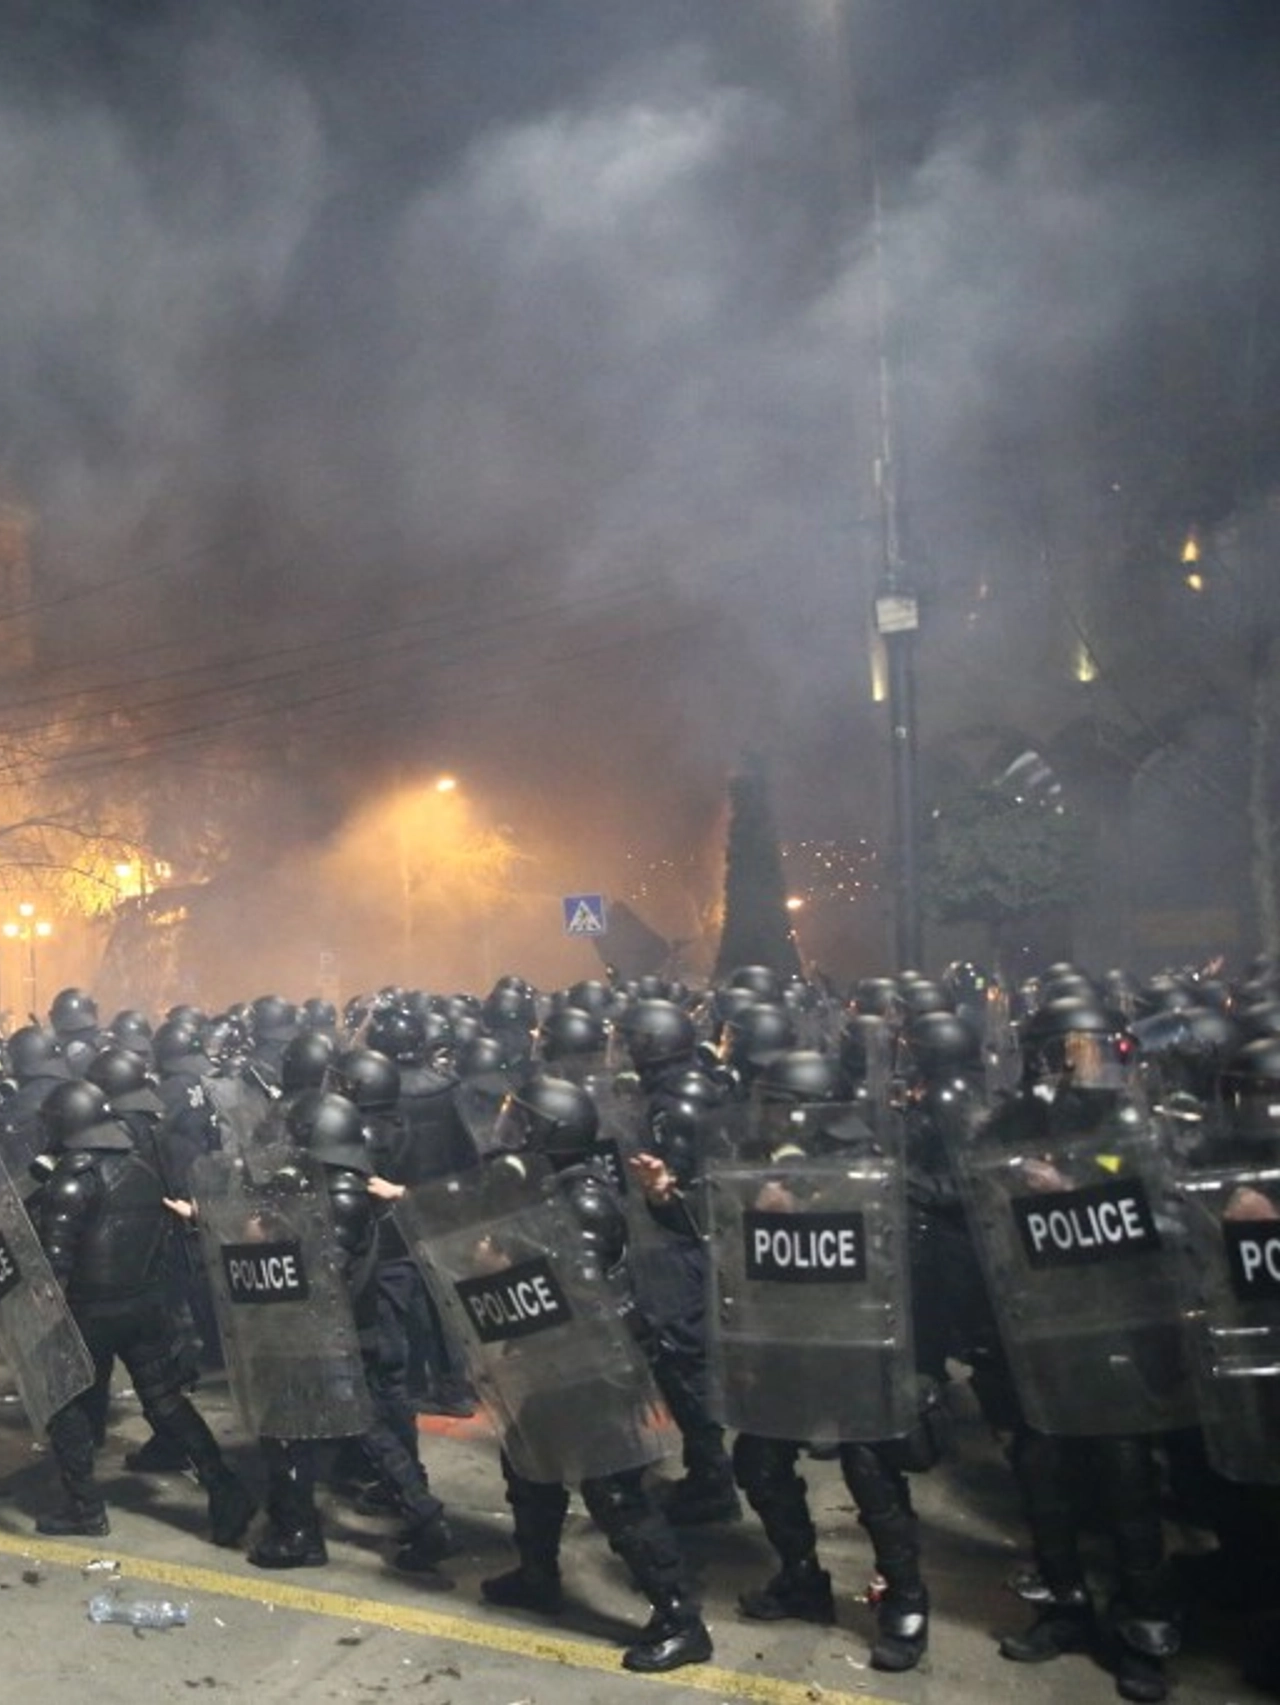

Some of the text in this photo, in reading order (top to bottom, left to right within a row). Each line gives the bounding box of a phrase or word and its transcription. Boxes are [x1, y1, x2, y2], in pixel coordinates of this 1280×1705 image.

[1027, 1198, 1144, 1252] POLICE
[754, 1229, 856, 1267] POLICE
[229, 1255, 298, 1291] POLICE
[469, 1276, 557, 1326] POLICE
